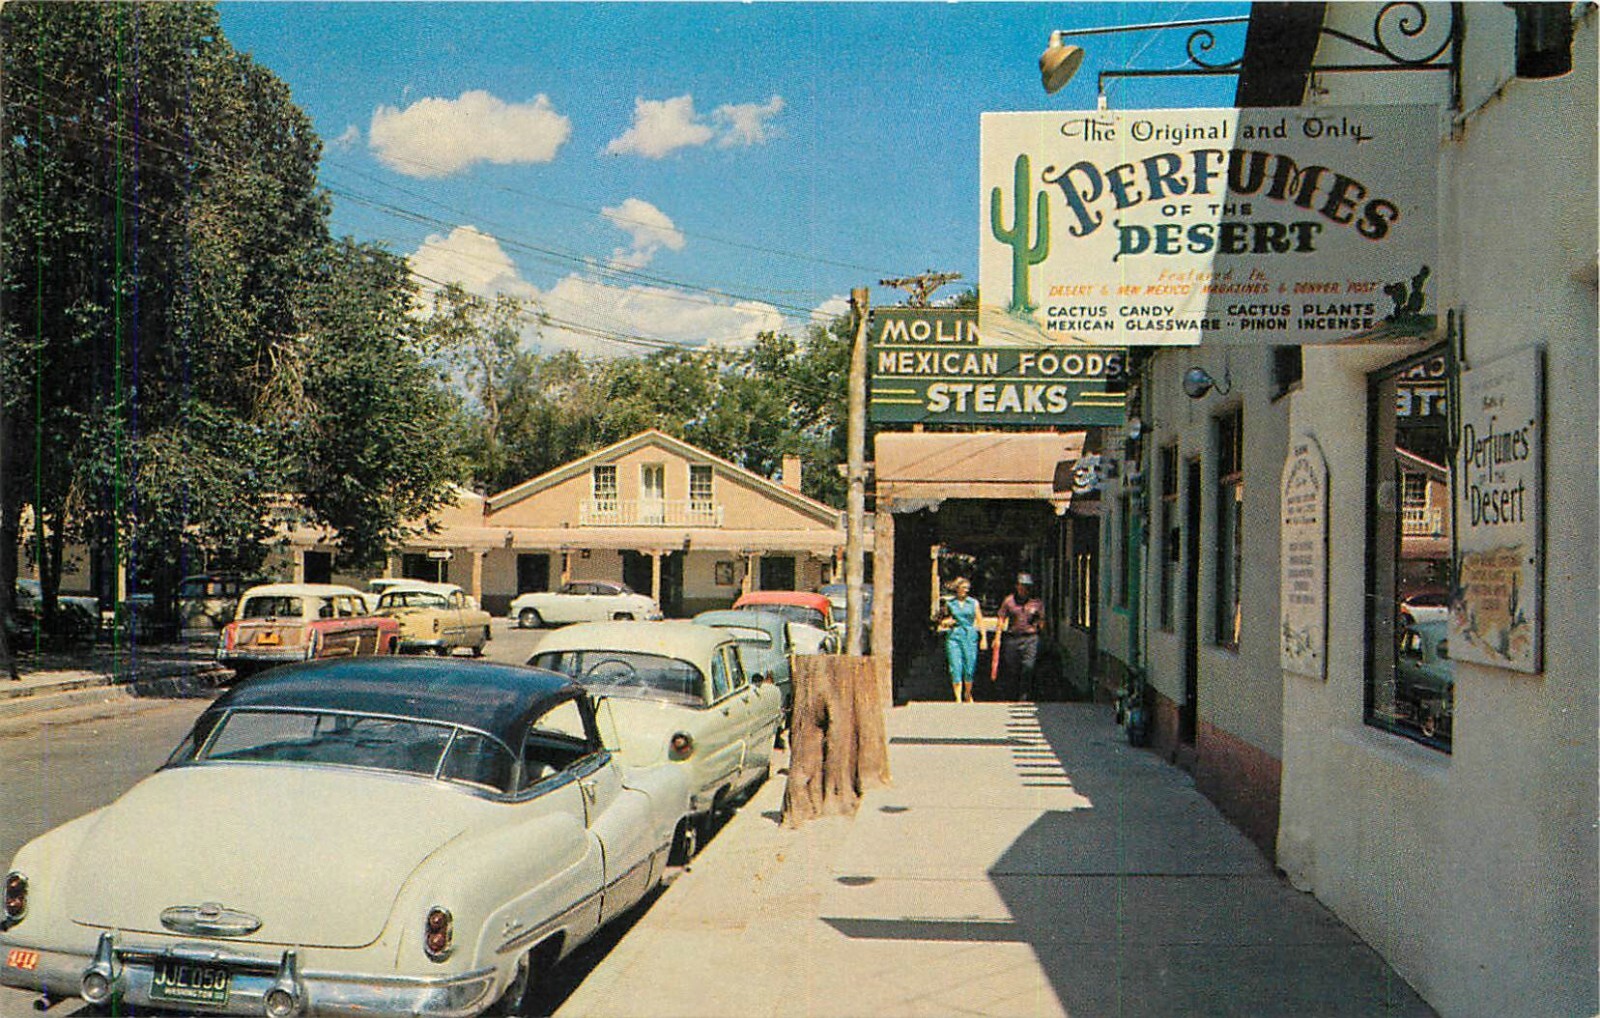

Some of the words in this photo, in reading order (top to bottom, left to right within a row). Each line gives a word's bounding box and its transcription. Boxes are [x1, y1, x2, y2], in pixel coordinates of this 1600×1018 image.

[1061, 118, 1115, 141] The
[1131, 120, 1227, 145] Original
[1243, 118, 1287, 138] and
[1303, 117, 1373, 143] Only
[1042, 149, 1399, 240] PERFUMES
[1161, 204, 1191, 216] OF
[1208, 203, 1252, 216] THE
[1113, 219, 1322, 262] DESERT
[1047, 306, 1108, 317] CACTUS
[1119, 306, 1174, 317] CANDY
[1228, 304, 1291, 316] CACTUS
[1303, 303, 1375, 316] PLANTS
[1047, 319, 1114, 331] MEXICAN
[1126, 319, 1221, 331] GLASSWARE
[1241, 318, 1287, 330] PINON
[1298, 317, 1374, 330] INCENSE
[878, 352, 998, 374] MEXICAN
[1018, 353, 1121, 375] FOODS
[926, 383, 1067, 414] STEAKS
[1464, 419, 1529, 500] Perfumes
[1471, 479, 1525, 526] Desert
